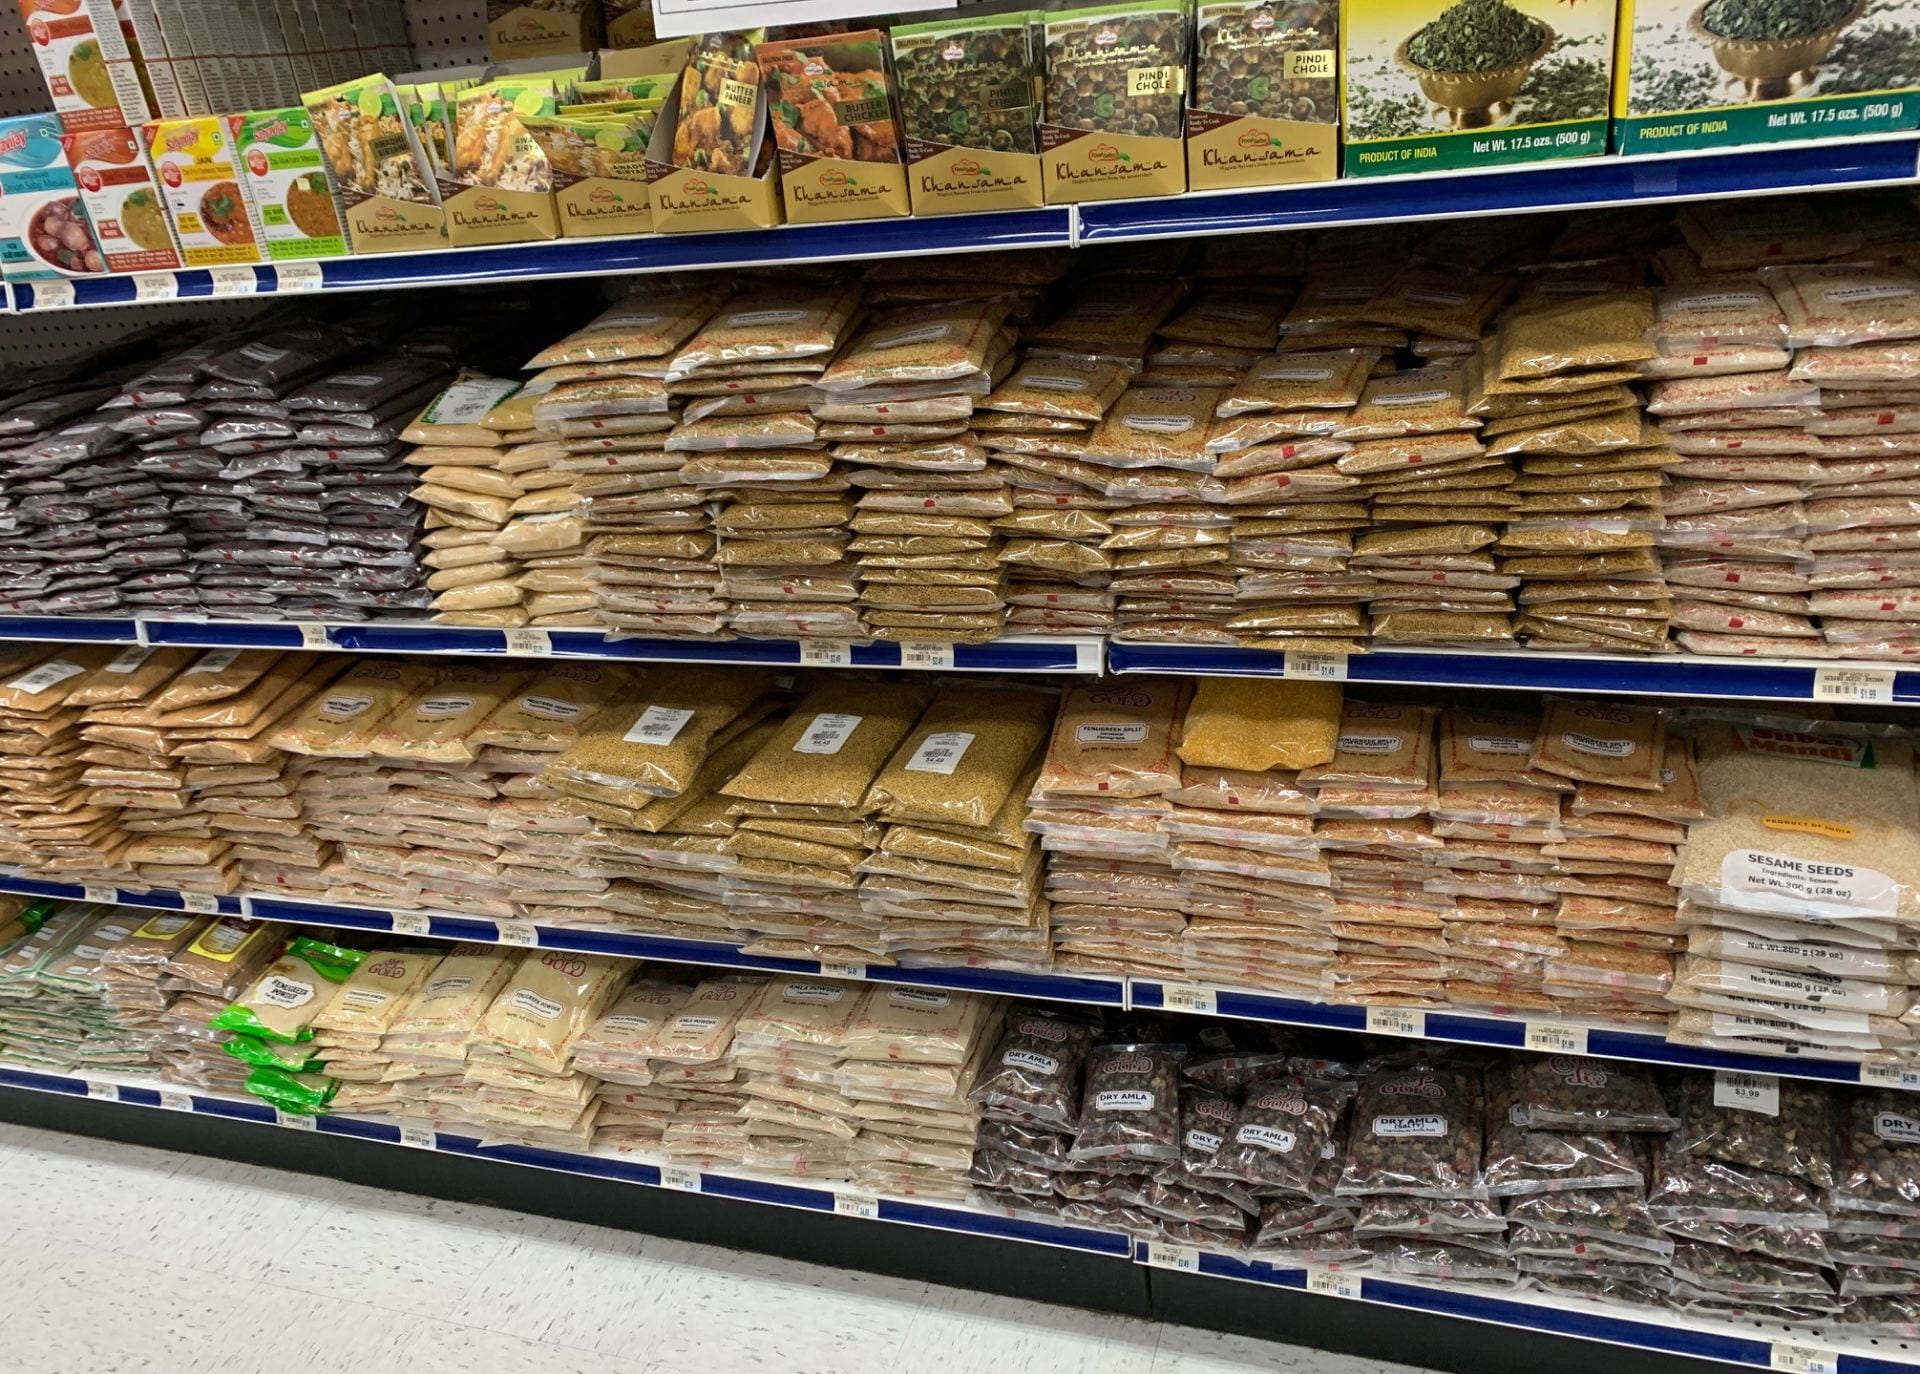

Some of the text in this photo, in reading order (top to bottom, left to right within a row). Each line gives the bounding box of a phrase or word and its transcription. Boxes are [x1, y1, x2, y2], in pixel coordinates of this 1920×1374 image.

[1295, 55, 1326, 65] PINDI
[1138, 71, 1168, 81] PINDI
[1292, 64, 1328, 73] CHOLE
[725, 83, 754, 96] MUTTER
[1136, 80, 1170, 90] CHOLE
[724, 91, 752, 105] PANEER
[845, 101, 884, 113] BUTTER
[1768, 102, 1903, 127] Net Wt. 17.5 ozs. (500 g)
[843, 109, 888, 122] CHICKEN
[1640, 120, 1727, 139] PRODUCT OF INDIA
[1473, 130, 1591, 153] Net Wt. 17.5 ozs. (500 g)
[1203, 146, 1320, 166] Khansama
[1359, 147, 1437, 164] PRODUCT OF INDIA
[612, 161, 646, 170] AWADH
[1056, 159, 1168, 181] Khansama
[921, 175, 1027, 194] Khansama
[793, 184, 892, 202] Khansama
[659, 193, 752, 211] Khansama
[567, 202, 651, 218] Khansama
[453, 210, 538, 226] Khansama
[356, 219, 435, 234] Khansama
[1765, 817, 1808, 828] PRODUCT
[1825, 824, 1852, 835] INDIA
[1748, 853, 1854, 878] SESAME SEEDS
[1748, 875, 1766, 886] Net
[1806, 886, 1813, 895] g
[1815, 886, 1833, 896] (28
[1835, 889, 1852, 899] oz)
[1747, 941, 1764, 949] Net
[1810, 947, 1827, 958] (28
[1829, 950, 1844, 960] oz)
[368, 963, 406, 979] GOLD
[541, 951, 586, 977] GOLD
[1750, 974, 1767, 983] Net
[271, 988, 298, 1000] POWDER
[272, 979, 309, 996] FENUGREEK
[809, 985, 840, 993] POWDER
[915, 989, 946, 999] POWDER
[1735, 1016, 1751, 1025] Net
[1008, 1051, 1052, 1066] DRY AMLA
[1102, 1056, 1154, 1074] GOLD
[1100, 1093, 1147, 1101] DRY AMLA
[1735, 1088, 1760, 1098] $3.99
[1257, 1095, 1308, 1116] GOLD
[1381, 1117, 1439, 1126] DRY AMLA
[1882, 1118, 1912, 1128] DRY
[1192, 1133, 1212, 1143] DRY
[1242, 1127, 1289, 1143] DRY AMLA
